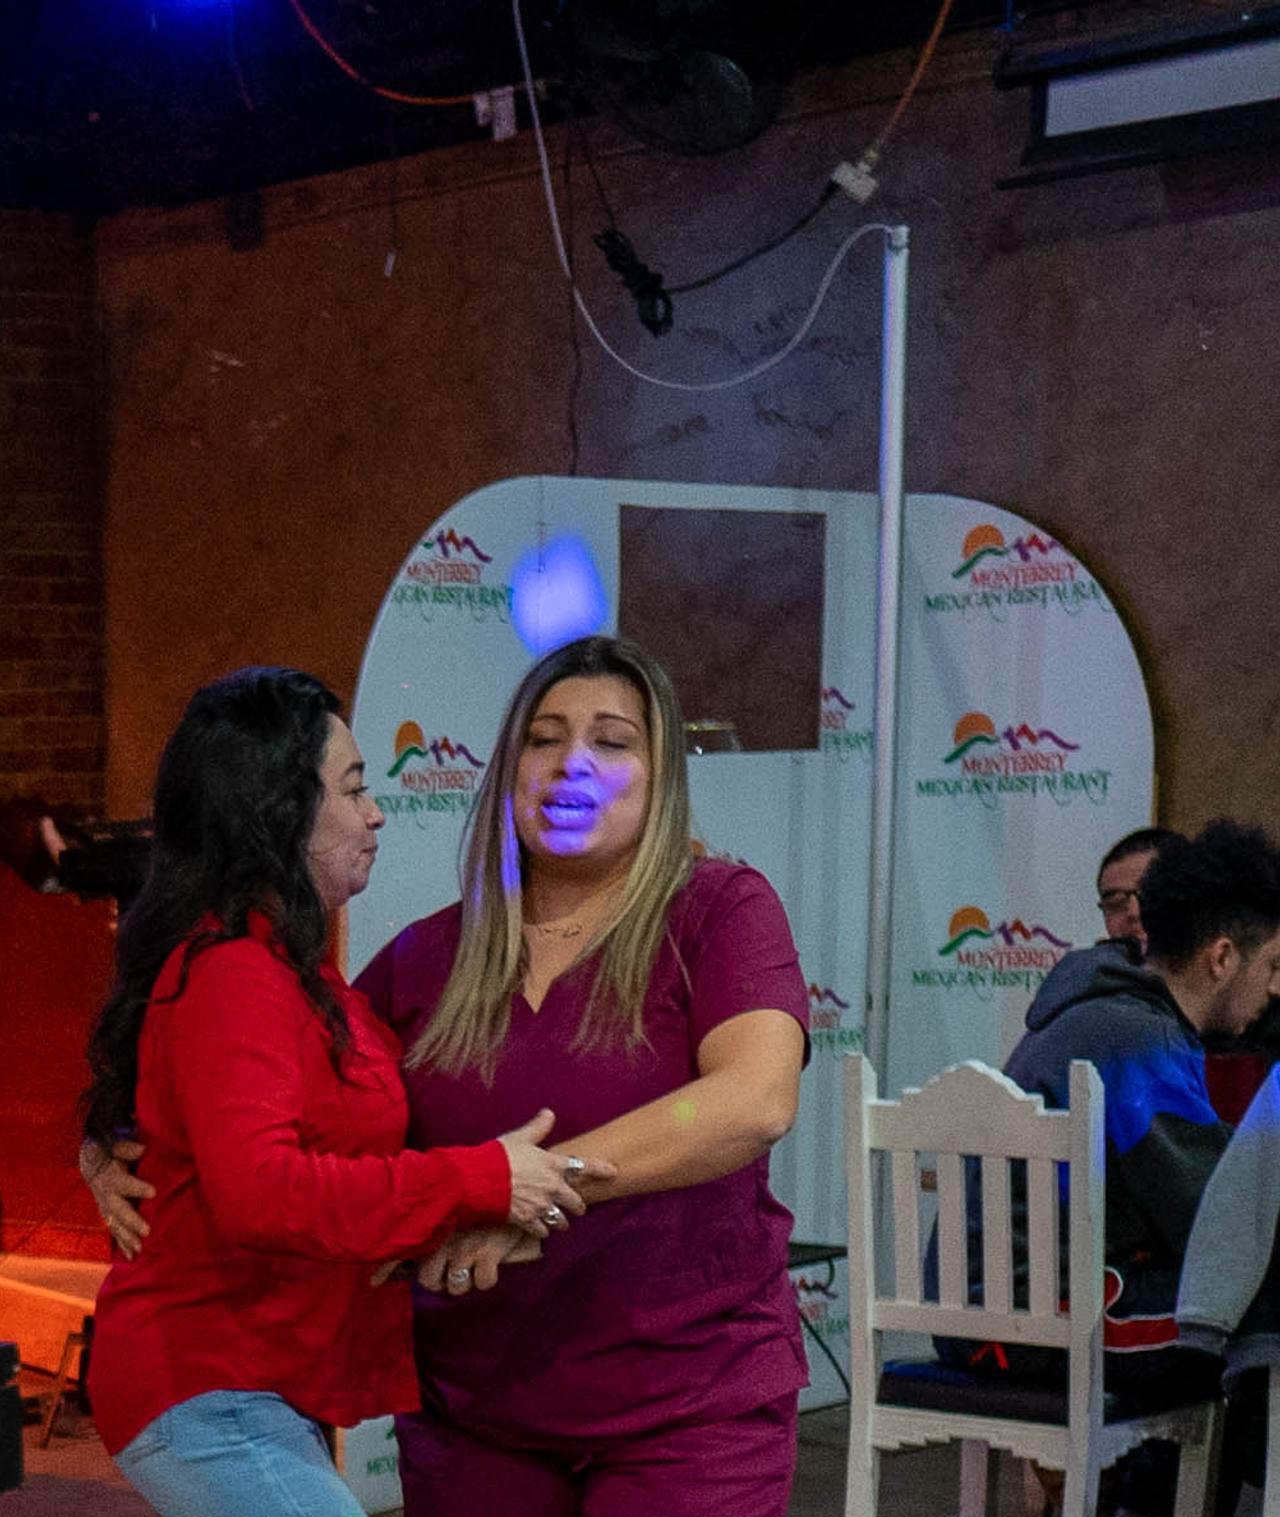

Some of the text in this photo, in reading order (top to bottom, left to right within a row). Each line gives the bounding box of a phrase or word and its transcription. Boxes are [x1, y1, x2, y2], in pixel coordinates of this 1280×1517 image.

[970, 560, 1078, 588] MONTERREY
[960, 750, 1067, 776] MONTERREY
[916, 765, 1113, 808] MEXICAN RESTAURANT
[912, 969, 992, 1001] MEXICAN
